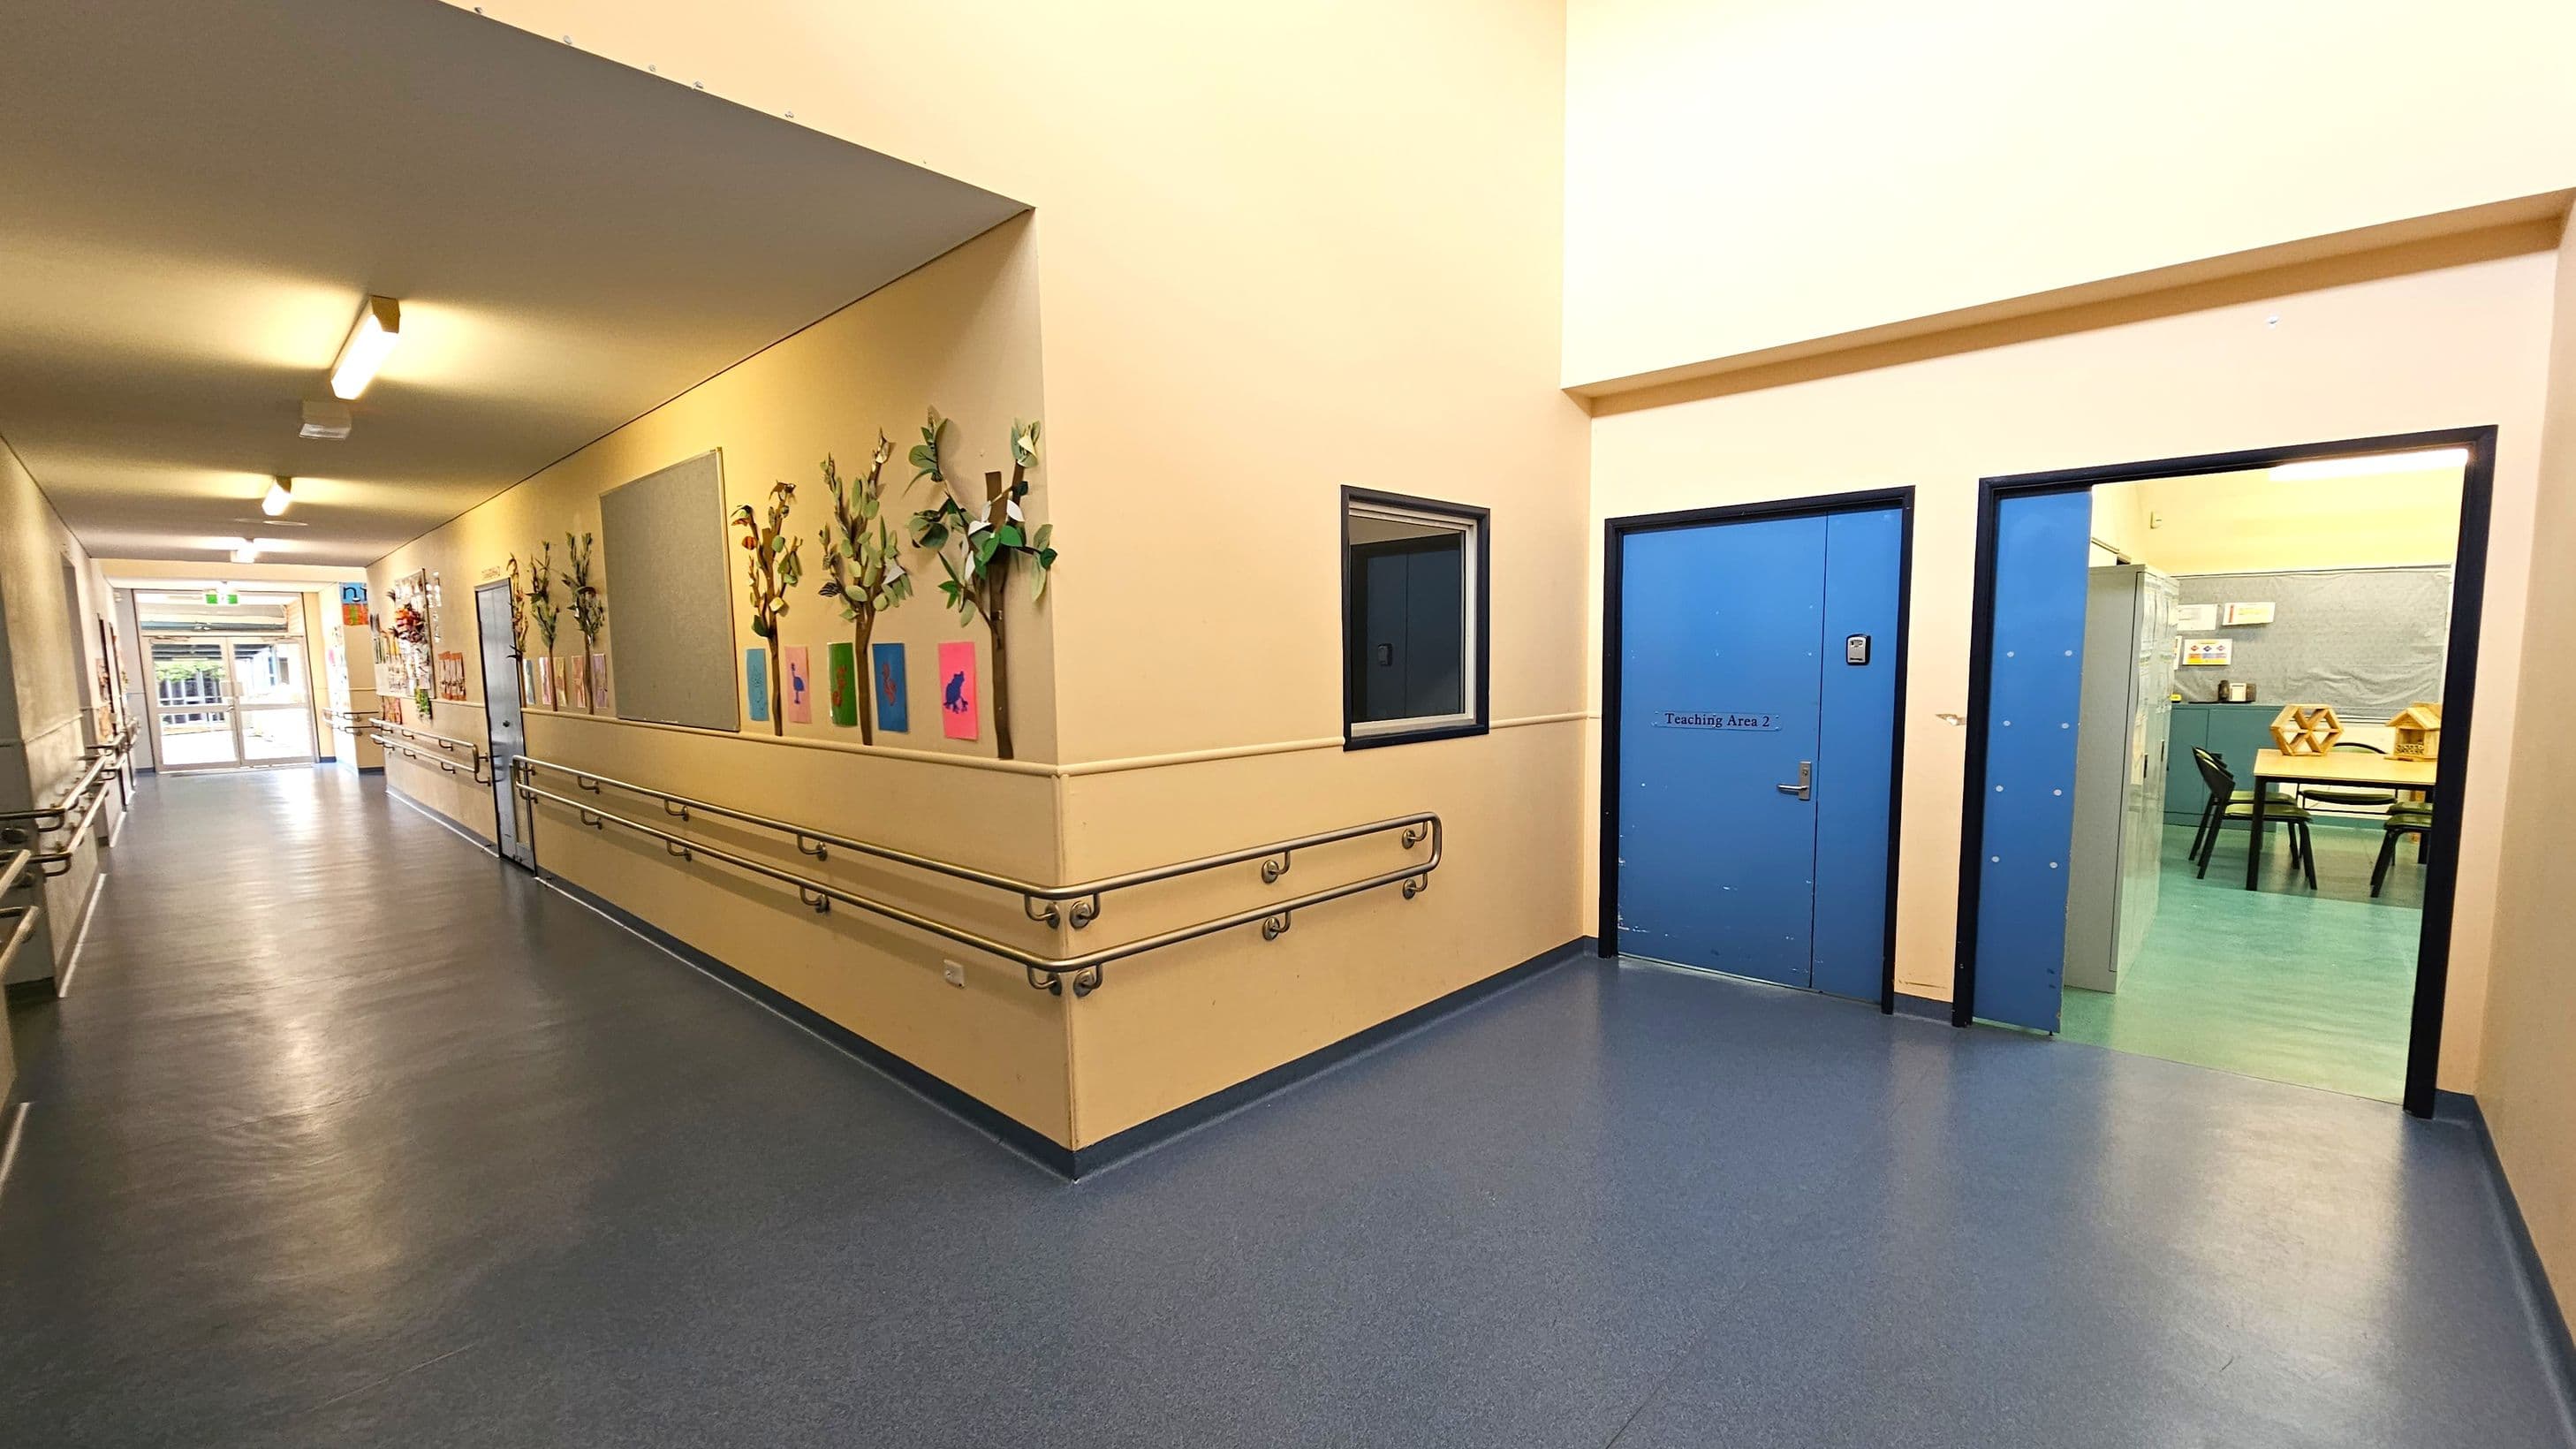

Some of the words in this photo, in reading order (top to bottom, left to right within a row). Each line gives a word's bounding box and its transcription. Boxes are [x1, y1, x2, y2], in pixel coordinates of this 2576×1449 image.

[1665, 713, 1723, 727] Teaching
[1727, 715, 1758, 726] Area
[1762, 716, 1769, 726] 2
